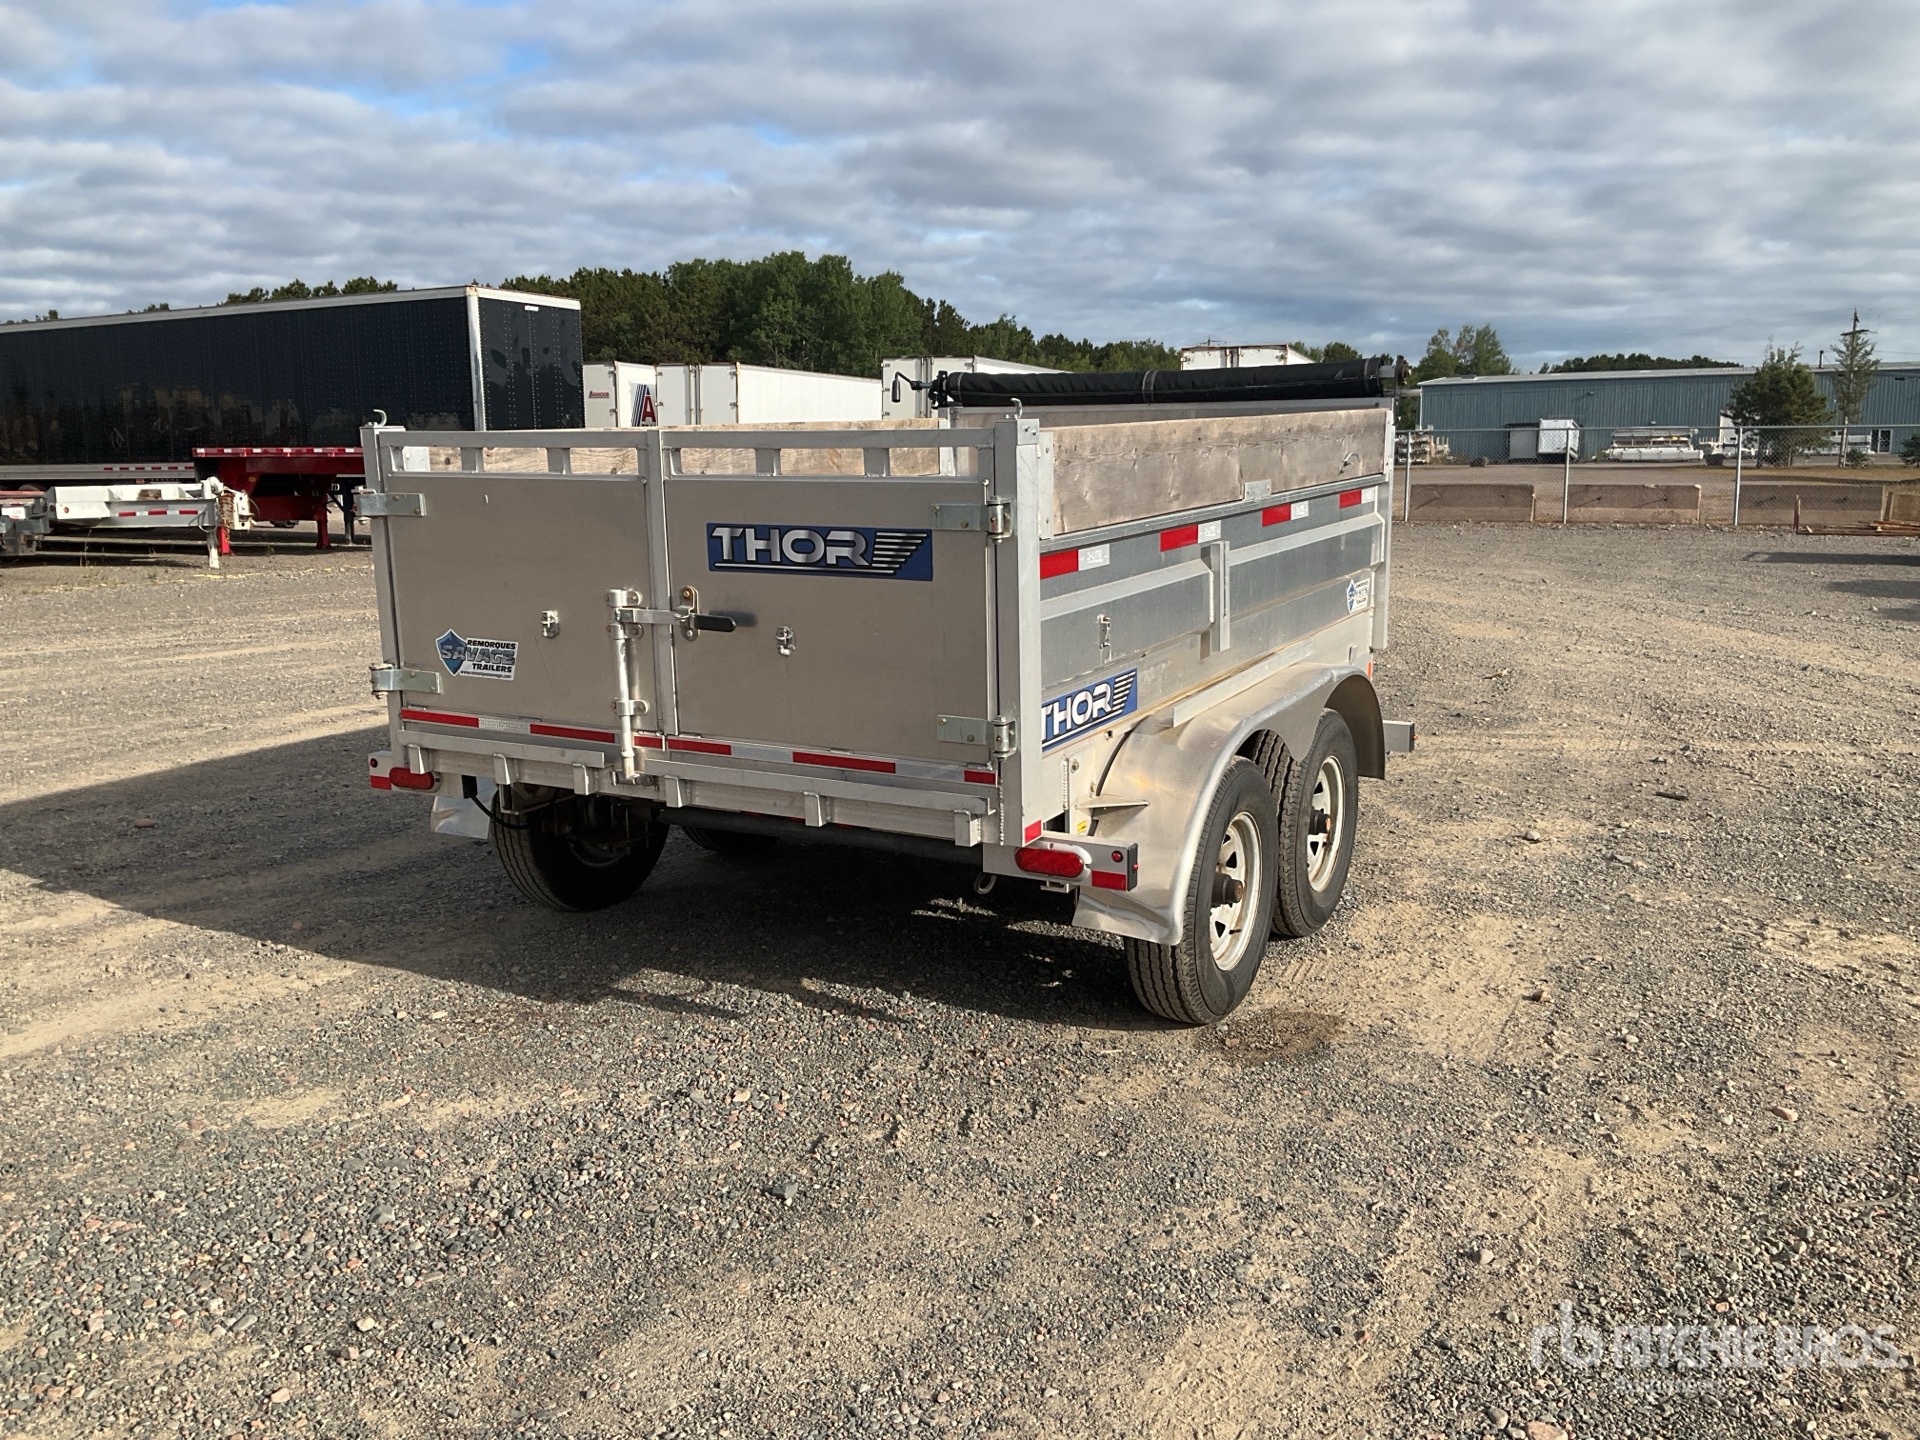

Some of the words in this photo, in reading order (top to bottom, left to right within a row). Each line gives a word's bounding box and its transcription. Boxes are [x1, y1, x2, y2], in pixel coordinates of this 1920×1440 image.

[711, 527, 870, 566] THOR
[440, 645, 515, 666] SAVAGE
[467, 640, 516, 650] REMORQUES
[472, 663, 512, 673] TRAILERS
[1041, 683, 1112, 742] THOR
